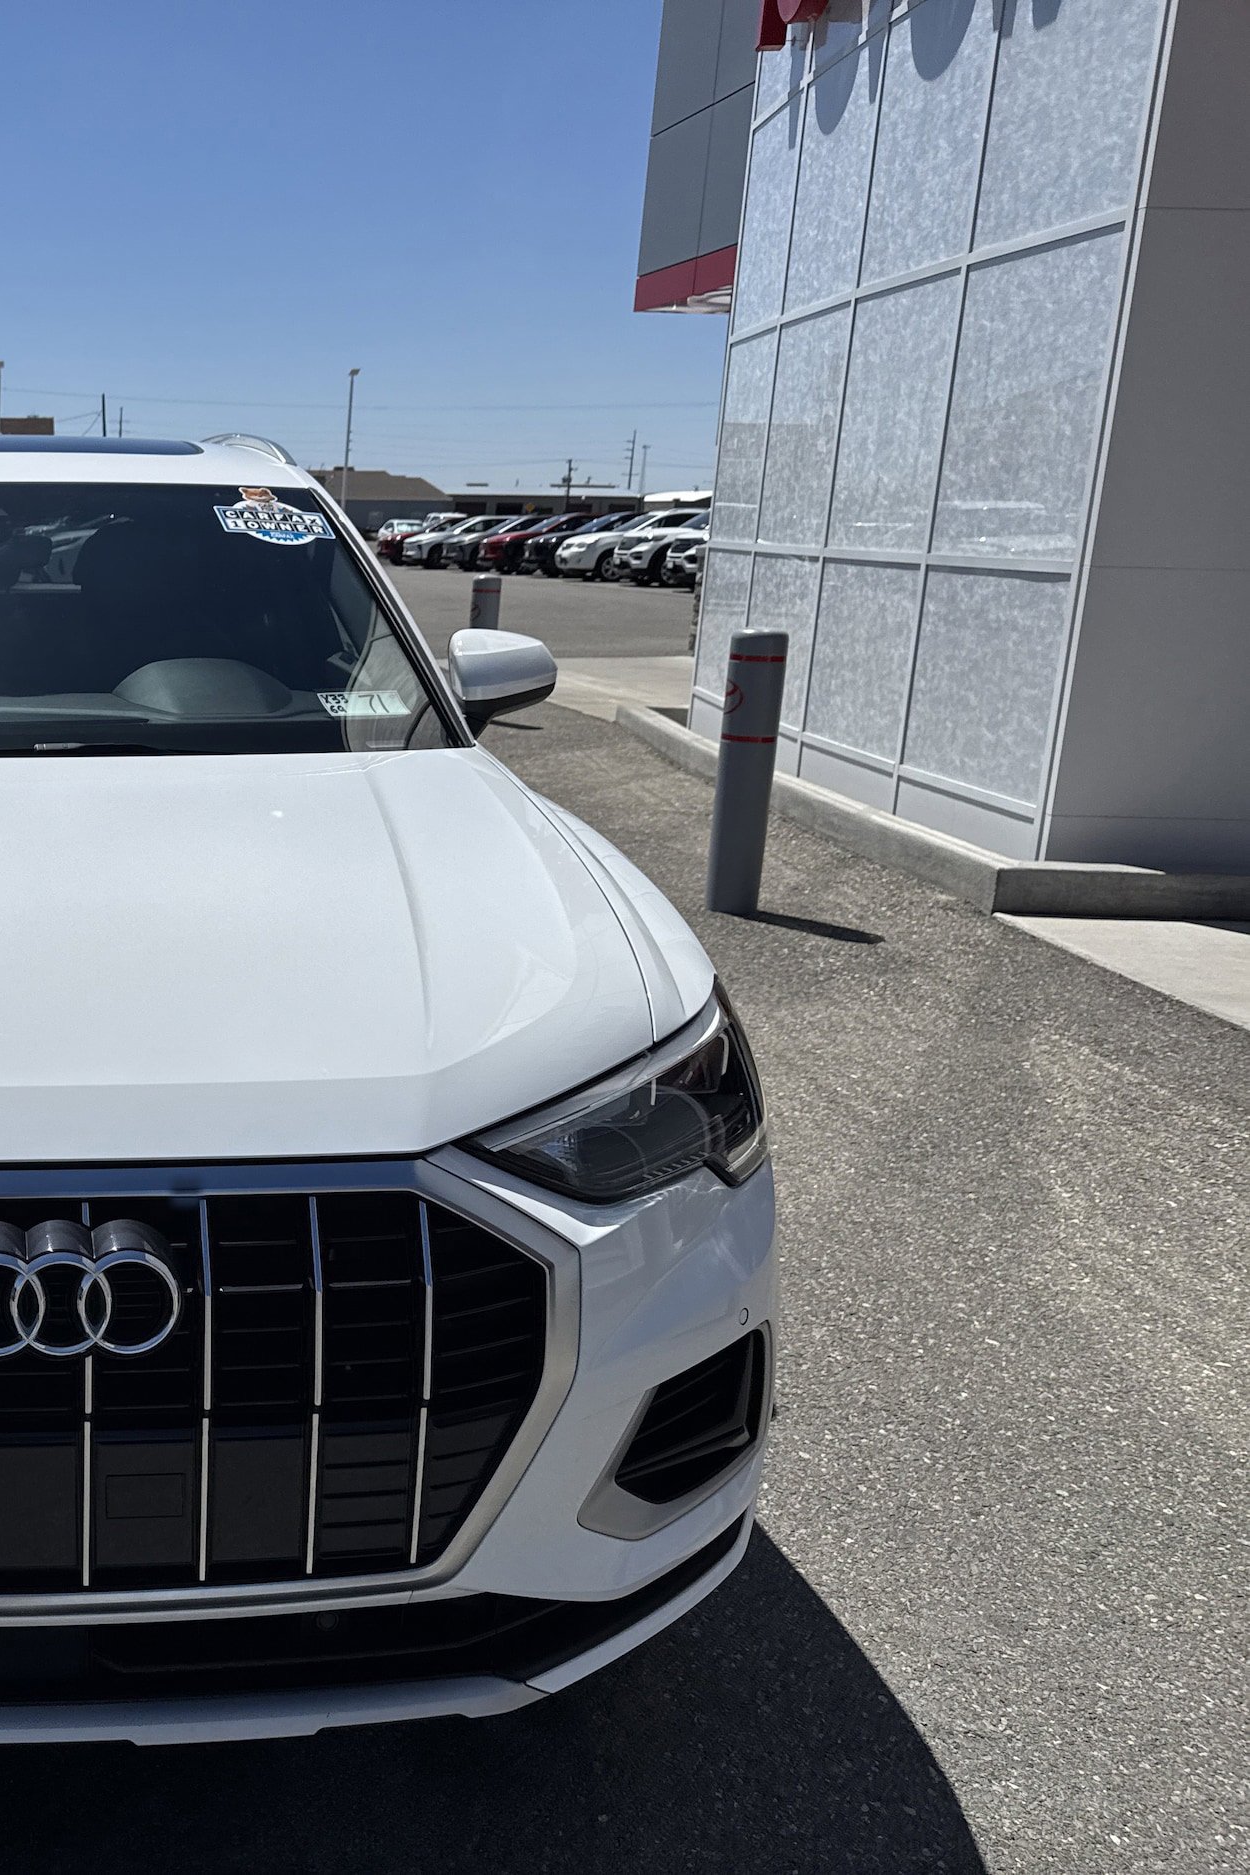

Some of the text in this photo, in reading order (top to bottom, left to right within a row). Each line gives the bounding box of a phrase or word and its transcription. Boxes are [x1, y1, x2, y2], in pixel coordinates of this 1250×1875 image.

[225, 510, 320, 526] CARFAX
[231, 520, 324, 535] 1 OWNER
